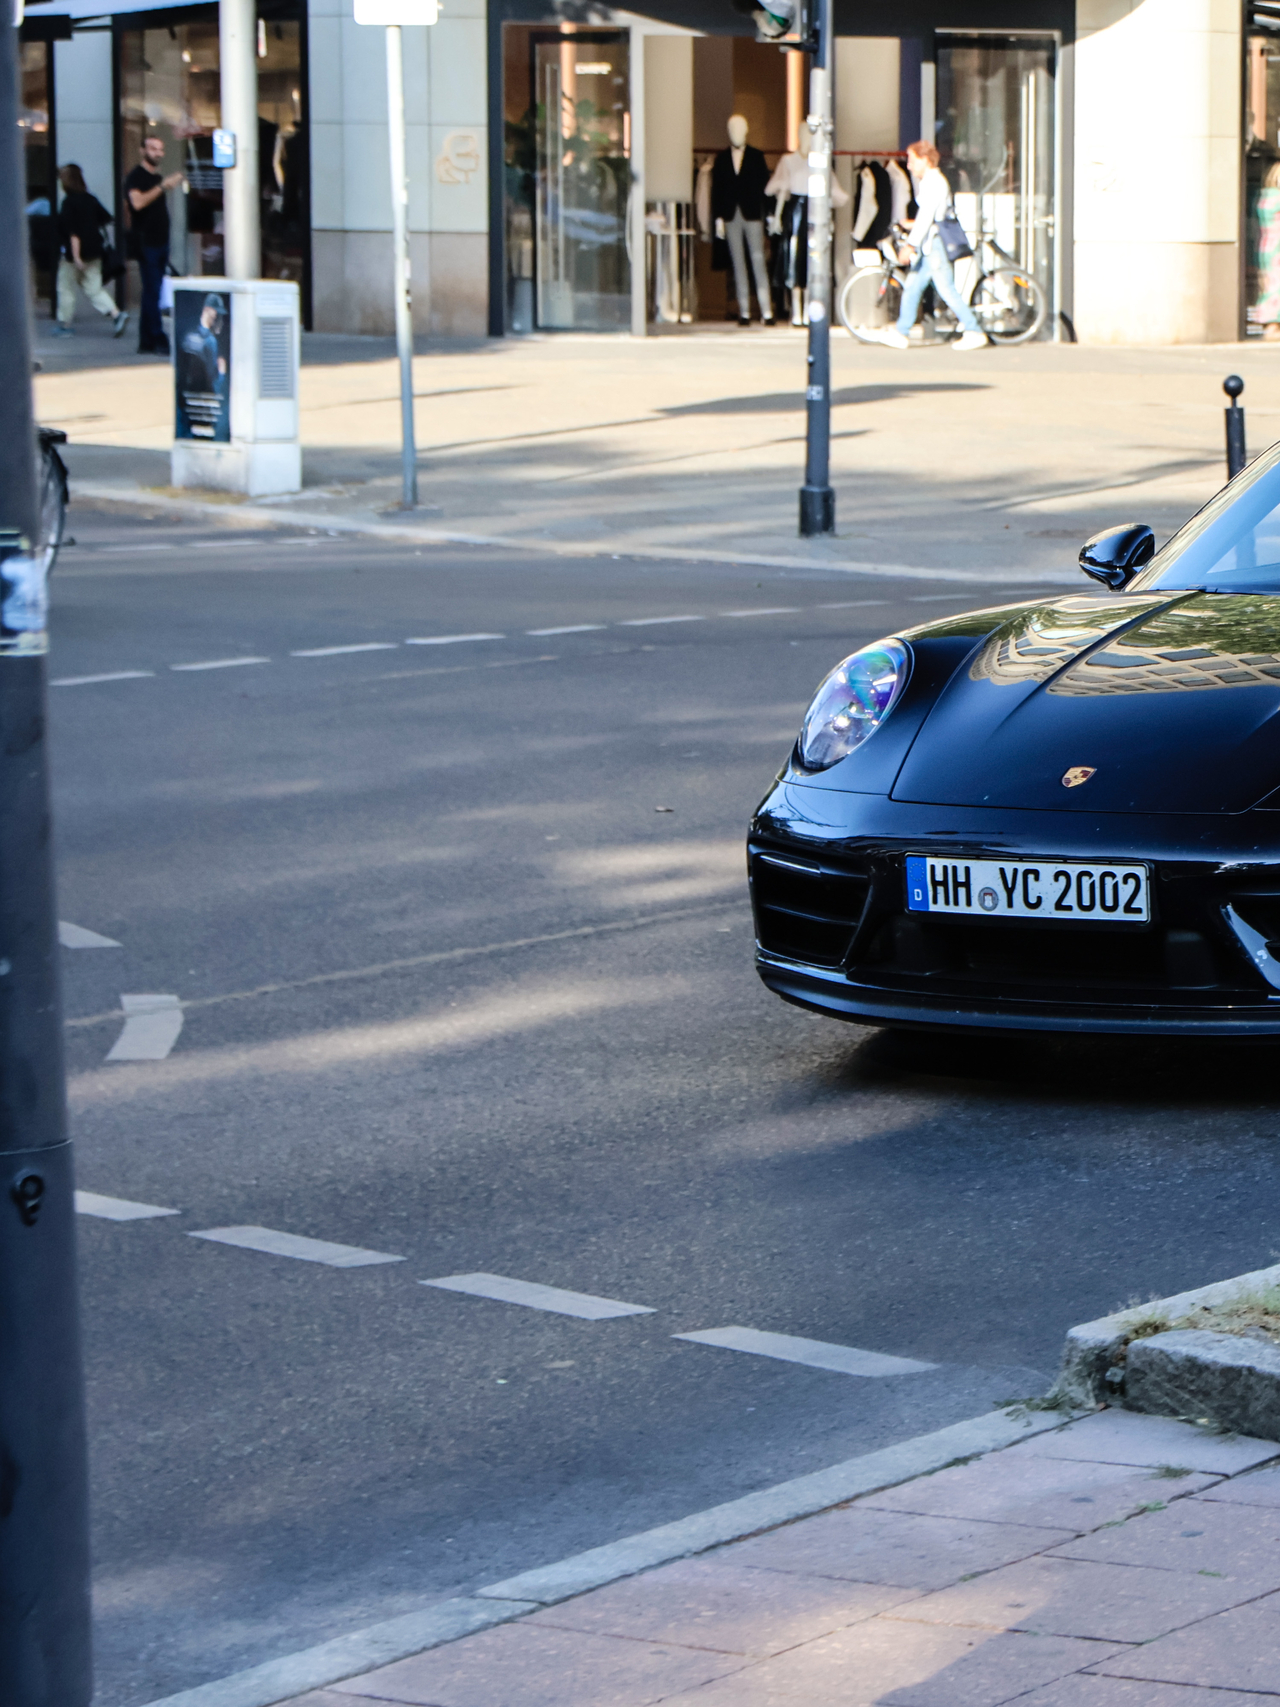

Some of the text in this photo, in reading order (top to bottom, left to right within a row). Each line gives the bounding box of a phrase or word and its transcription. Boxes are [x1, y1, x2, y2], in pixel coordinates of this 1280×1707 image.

[914, 888, 922, 901] D
[930, 864, 1143, 914] HH YC 2002
